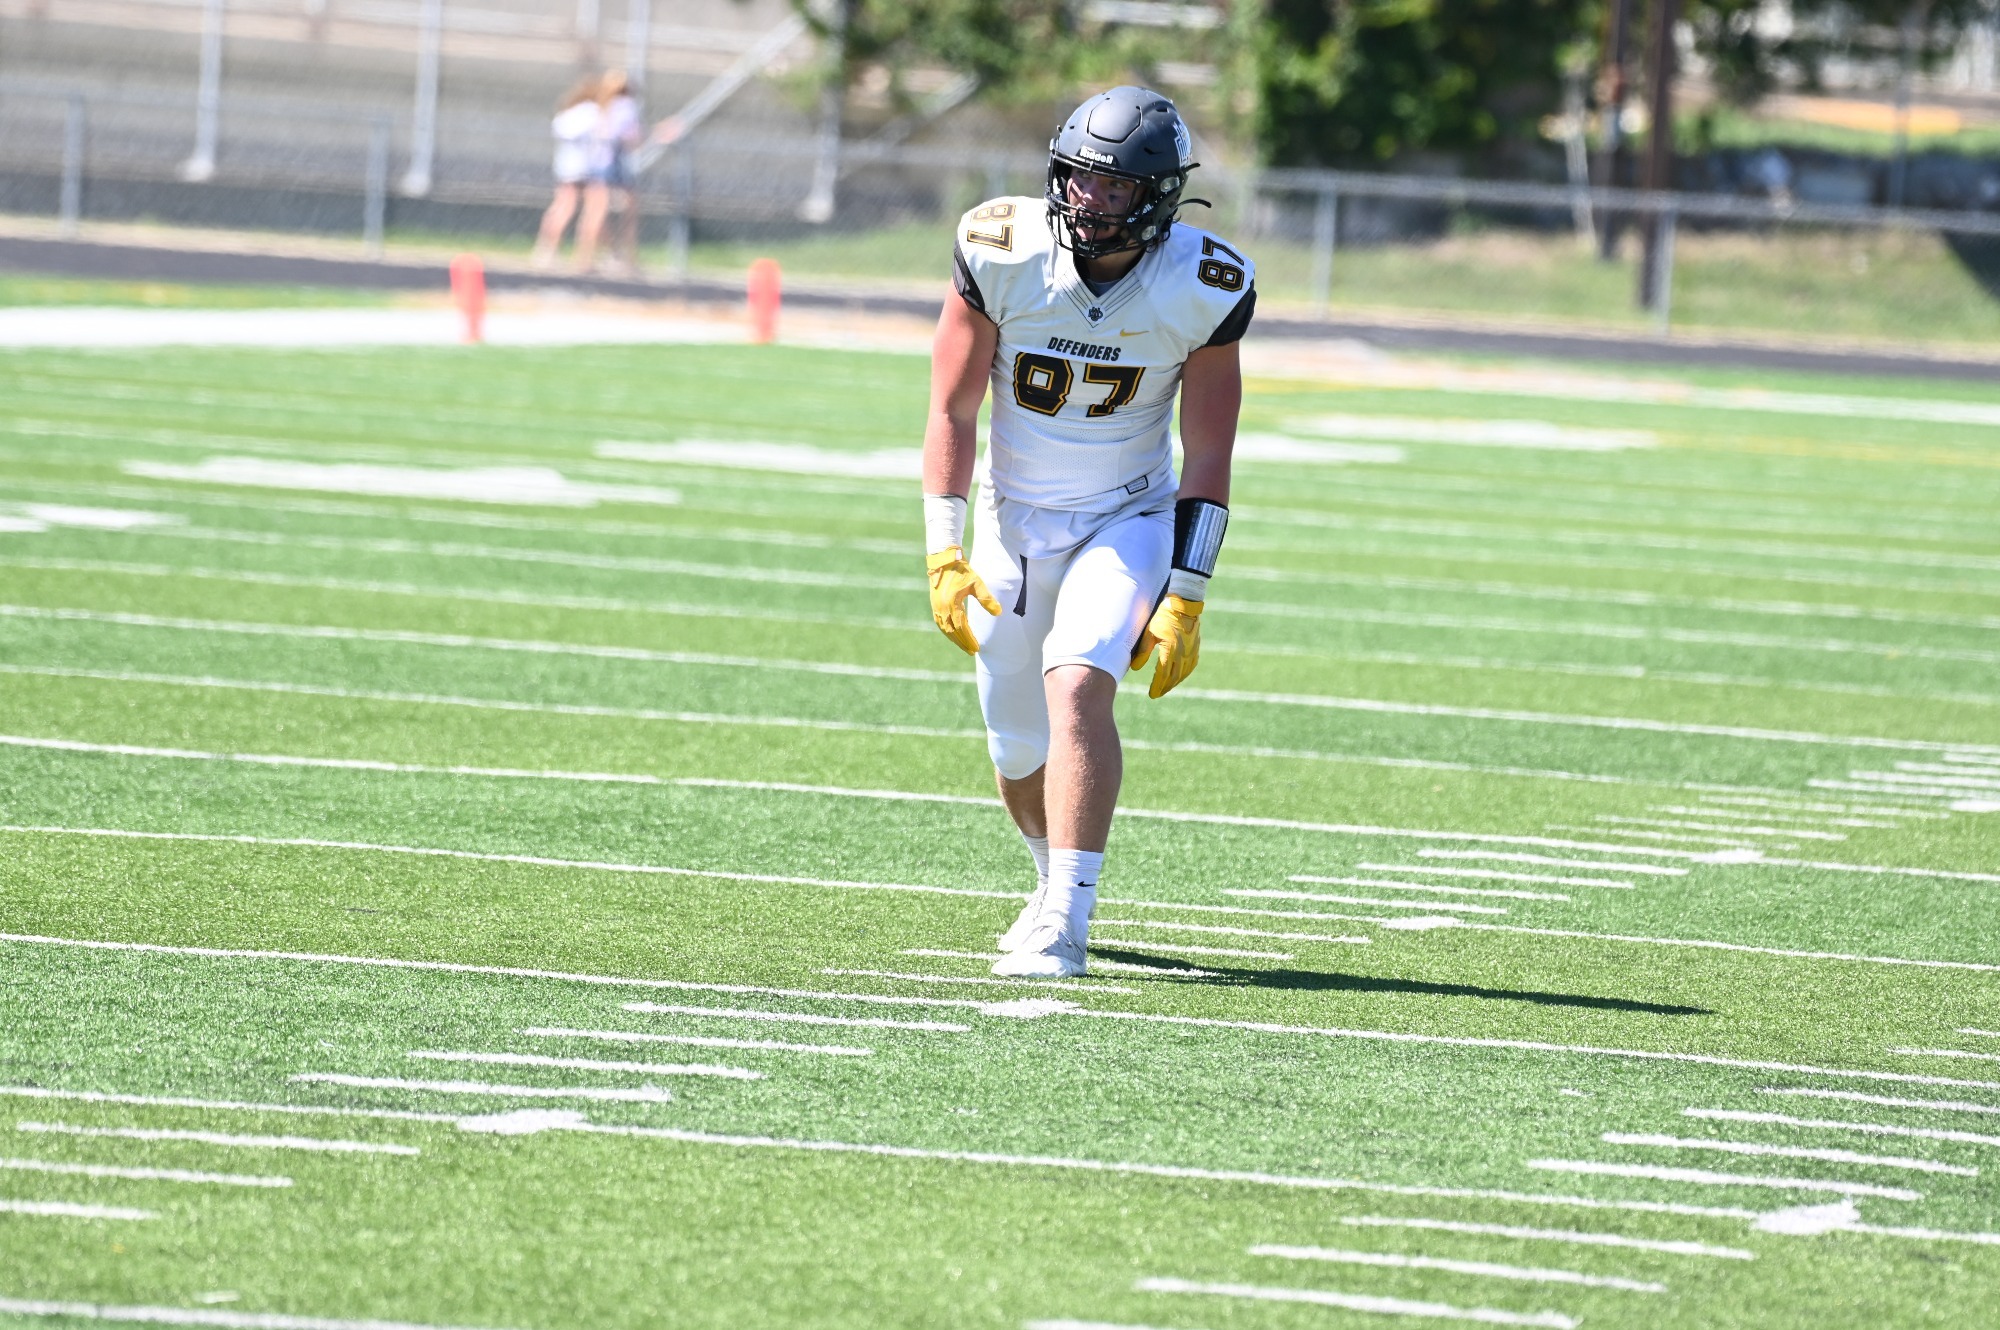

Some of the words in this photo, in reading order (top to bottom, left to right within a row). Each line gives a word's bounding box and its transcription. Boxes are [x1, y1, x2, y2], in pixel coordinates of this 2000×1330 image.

[1079, 145, 1114, 165] Riddell
[967, 203, 1017, 252] 87
[1197, 236, 1245, 293] 87
[1046, 336, 1122, 362] DEFENDERS
[1013, 351, 1147, 418] 87
